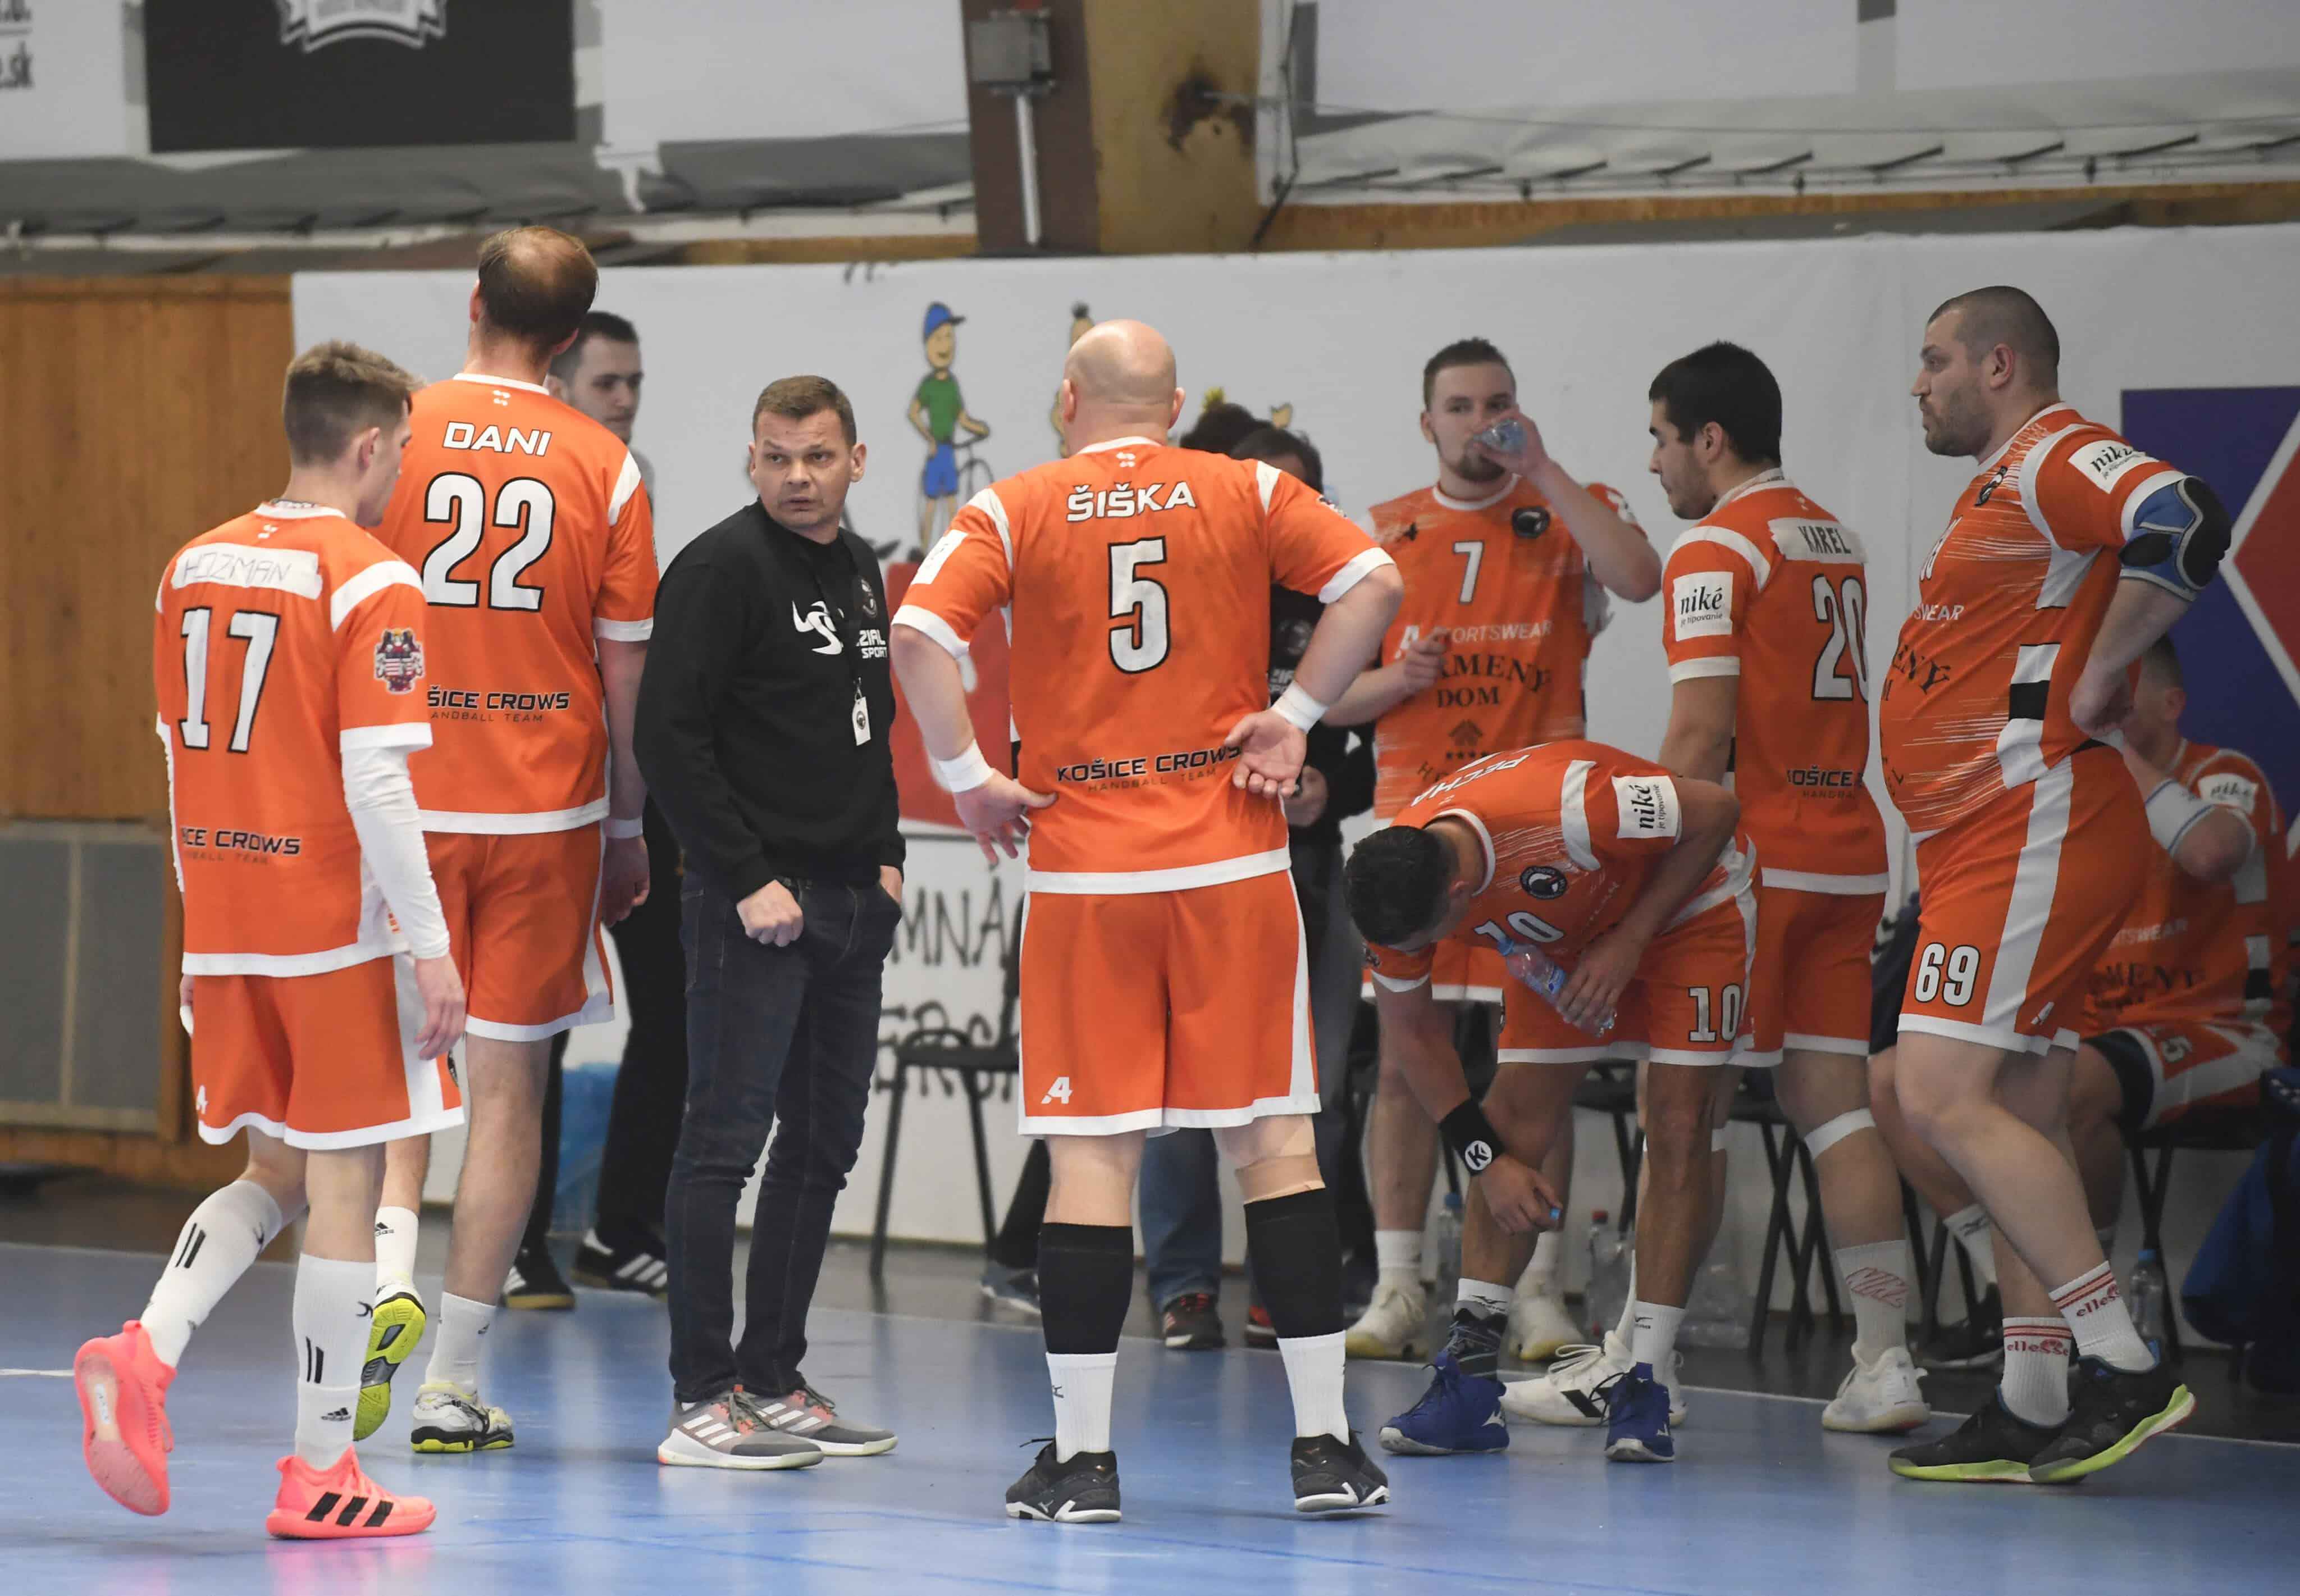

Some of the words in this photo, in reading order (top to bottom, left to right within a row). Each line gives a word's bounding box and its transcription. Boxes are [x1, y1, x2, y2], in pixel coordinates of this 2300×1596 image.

[442, 421, 552, 457] DANI
[1066, 481, 1197, 522] ŠIŠKA
[422, 472, 555, 612] 22
[1453, 540, 1484, 605] 7
[1108, 535, 1170, 674] 5
[1680, 586, 1722, 615] niké
[1811, 573, 1869, 704] 20
[179, 608, 281, 754] 17
[487, 692, 570, 710] CROWS
[1437, 686, 1500, 708] DOM
[505, 713, 544, 722] TEAM
[1057, 758, 1147, 782] KOŠICE
[1180, 767, 1216, 782] TEAM
[1628, 784, 1655, 830] niké
[216, 830, 301, 855] CROWS
[1914, 942, 1981, 1006] 69
[1689, 984, 1740, 1042] 10
